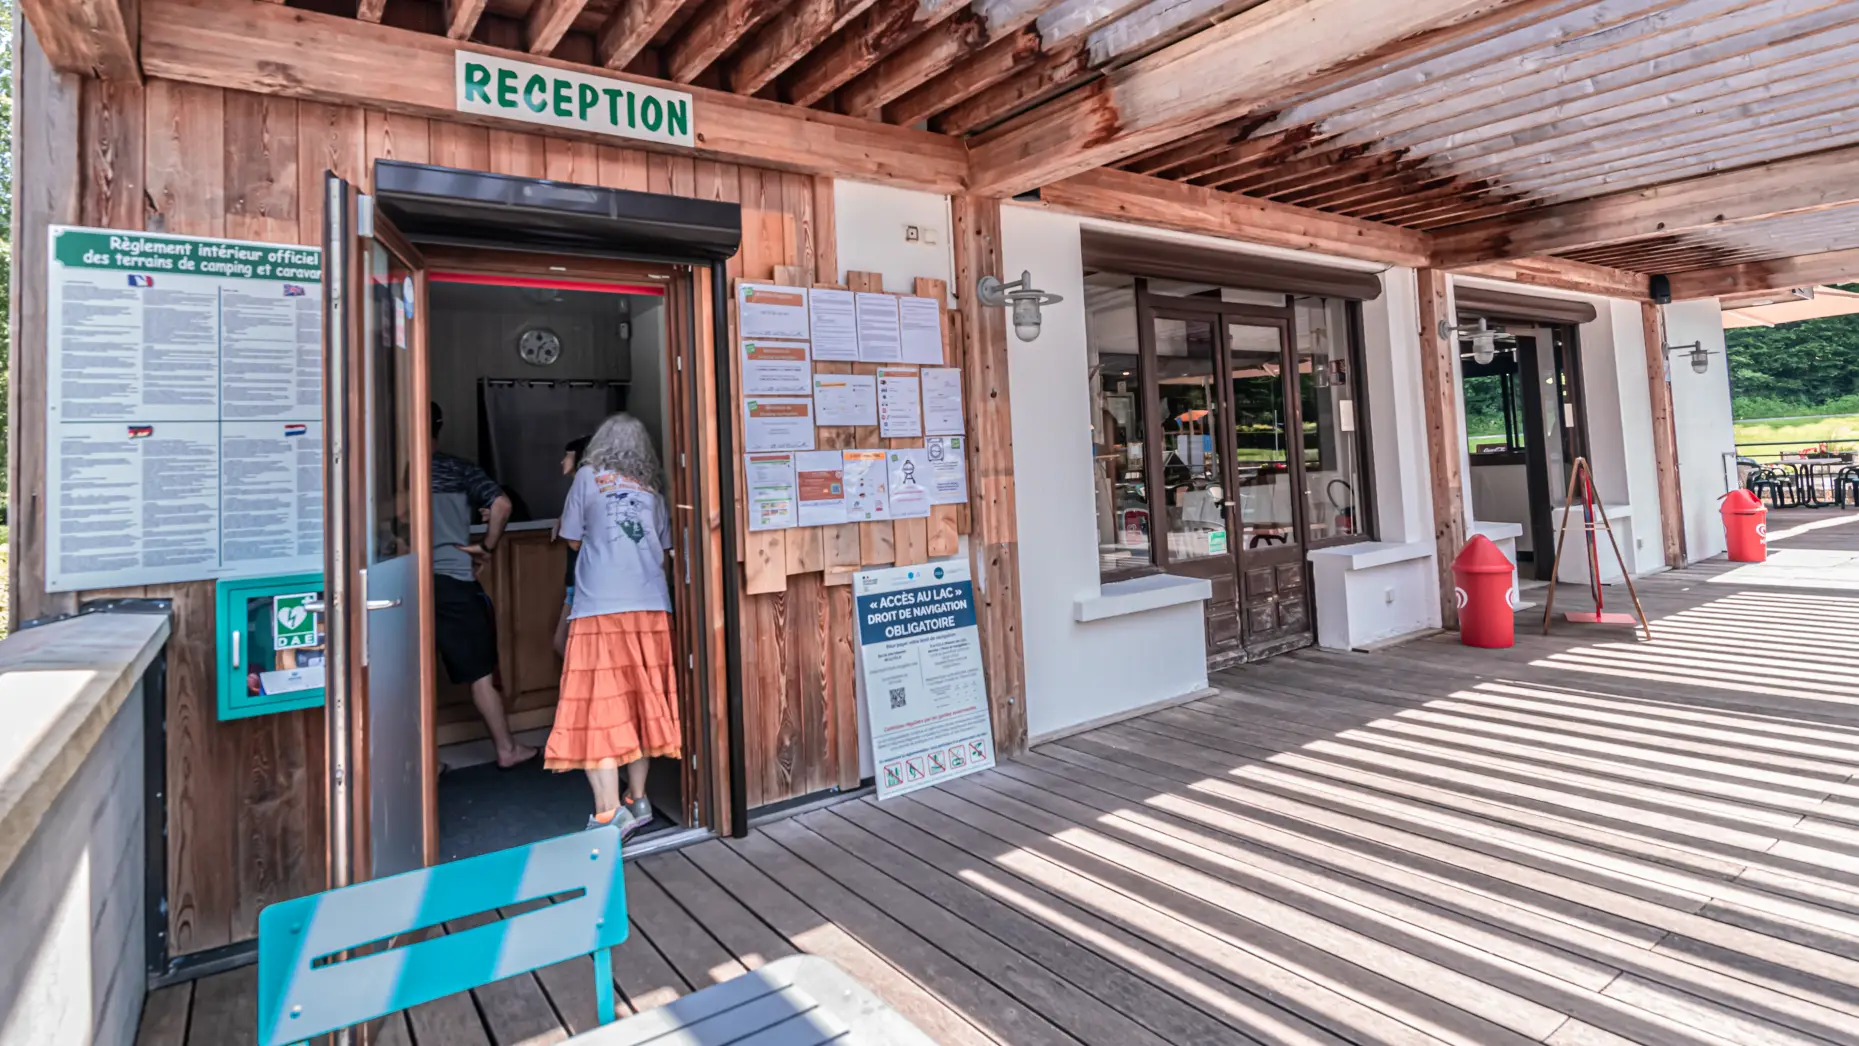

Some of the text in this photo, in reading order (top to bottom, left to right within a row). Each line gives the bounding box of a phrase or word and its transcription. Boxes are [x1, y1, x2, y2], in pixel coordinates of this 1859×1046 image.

[465, 62, 687, 136] RECEPTION
[83, 249, 109, 265] des
[114, 252, 173, 269] terrains
[177, 255, 195, 270] de
[200, 259, 251, 277] camping
[256, 263, 271, 276] et
[109, 236, 318, 265] Règlement intérieur officiel
[879, 591, 915, 609] ACCÈS
[916, 590, 932, 603] AU
[933, 587, 953, 600] LAC
[867, 599, 967, 625] DROIT DE NAVIGATION
[885, 615, 956, 638] OBLIGATOIRE
